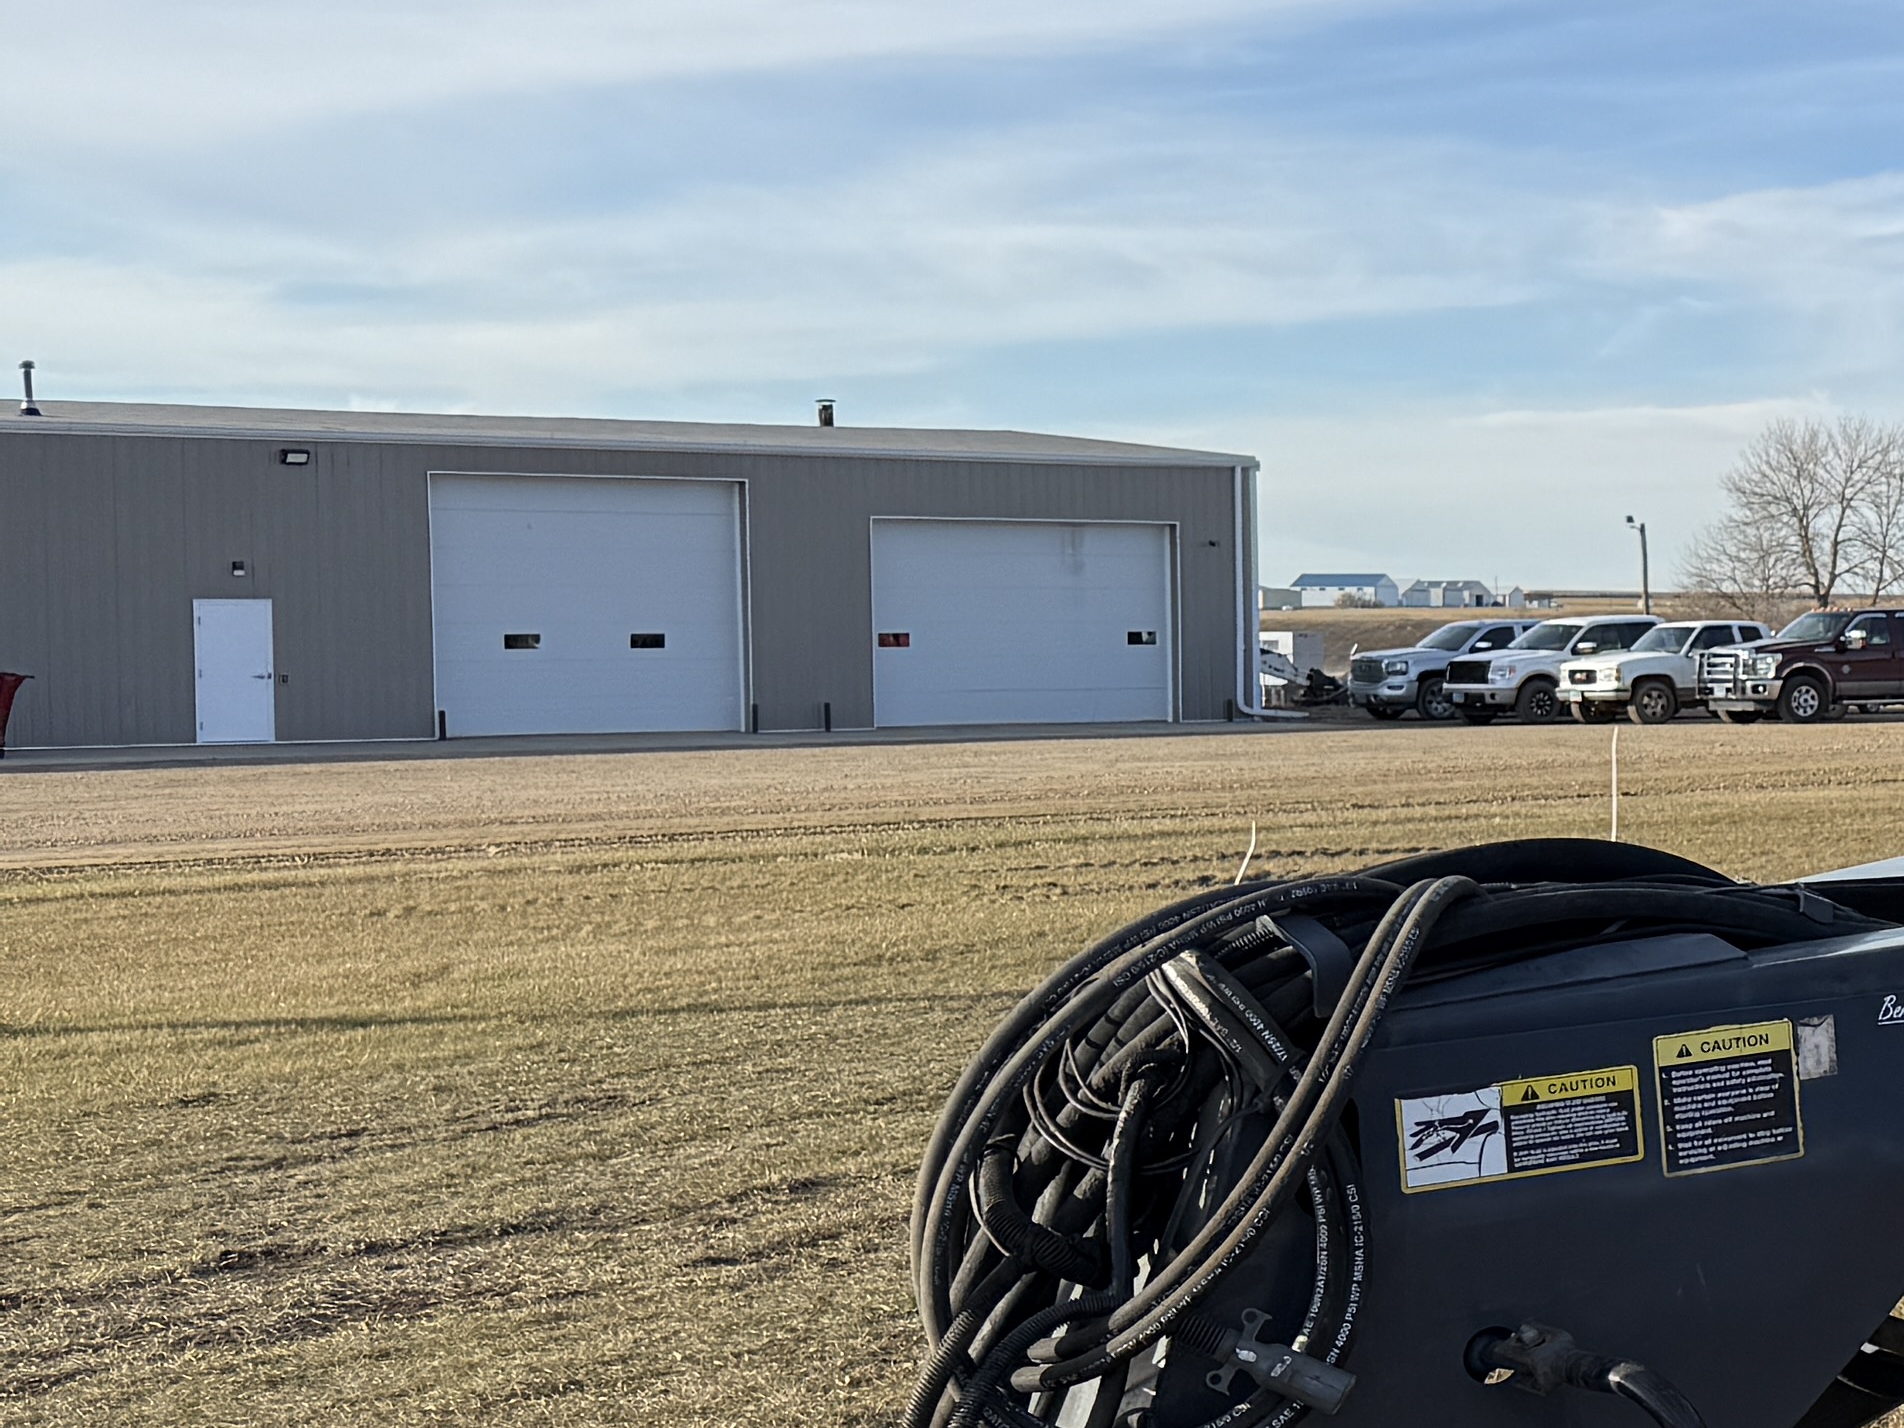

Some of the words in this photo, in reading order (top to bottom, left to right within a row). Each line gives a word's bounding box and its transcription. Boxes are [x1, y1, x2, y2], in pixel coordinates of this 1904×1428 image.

[1700, 1033, 1769, 1054] CAUTION
[1548, 1075, 1616, 1094] CAUTION
[1345, 1183, 1360, 1204] CSI
[1352, 1249, 1365, 1282] MSHA
[1350, 1283, 1361, 1303] WP
[1345, 1303, 1359, 1322] PSI
[1335, 1322, 1352, 1348] 4000
[1271, 1408, 1294, 1428] SAE
